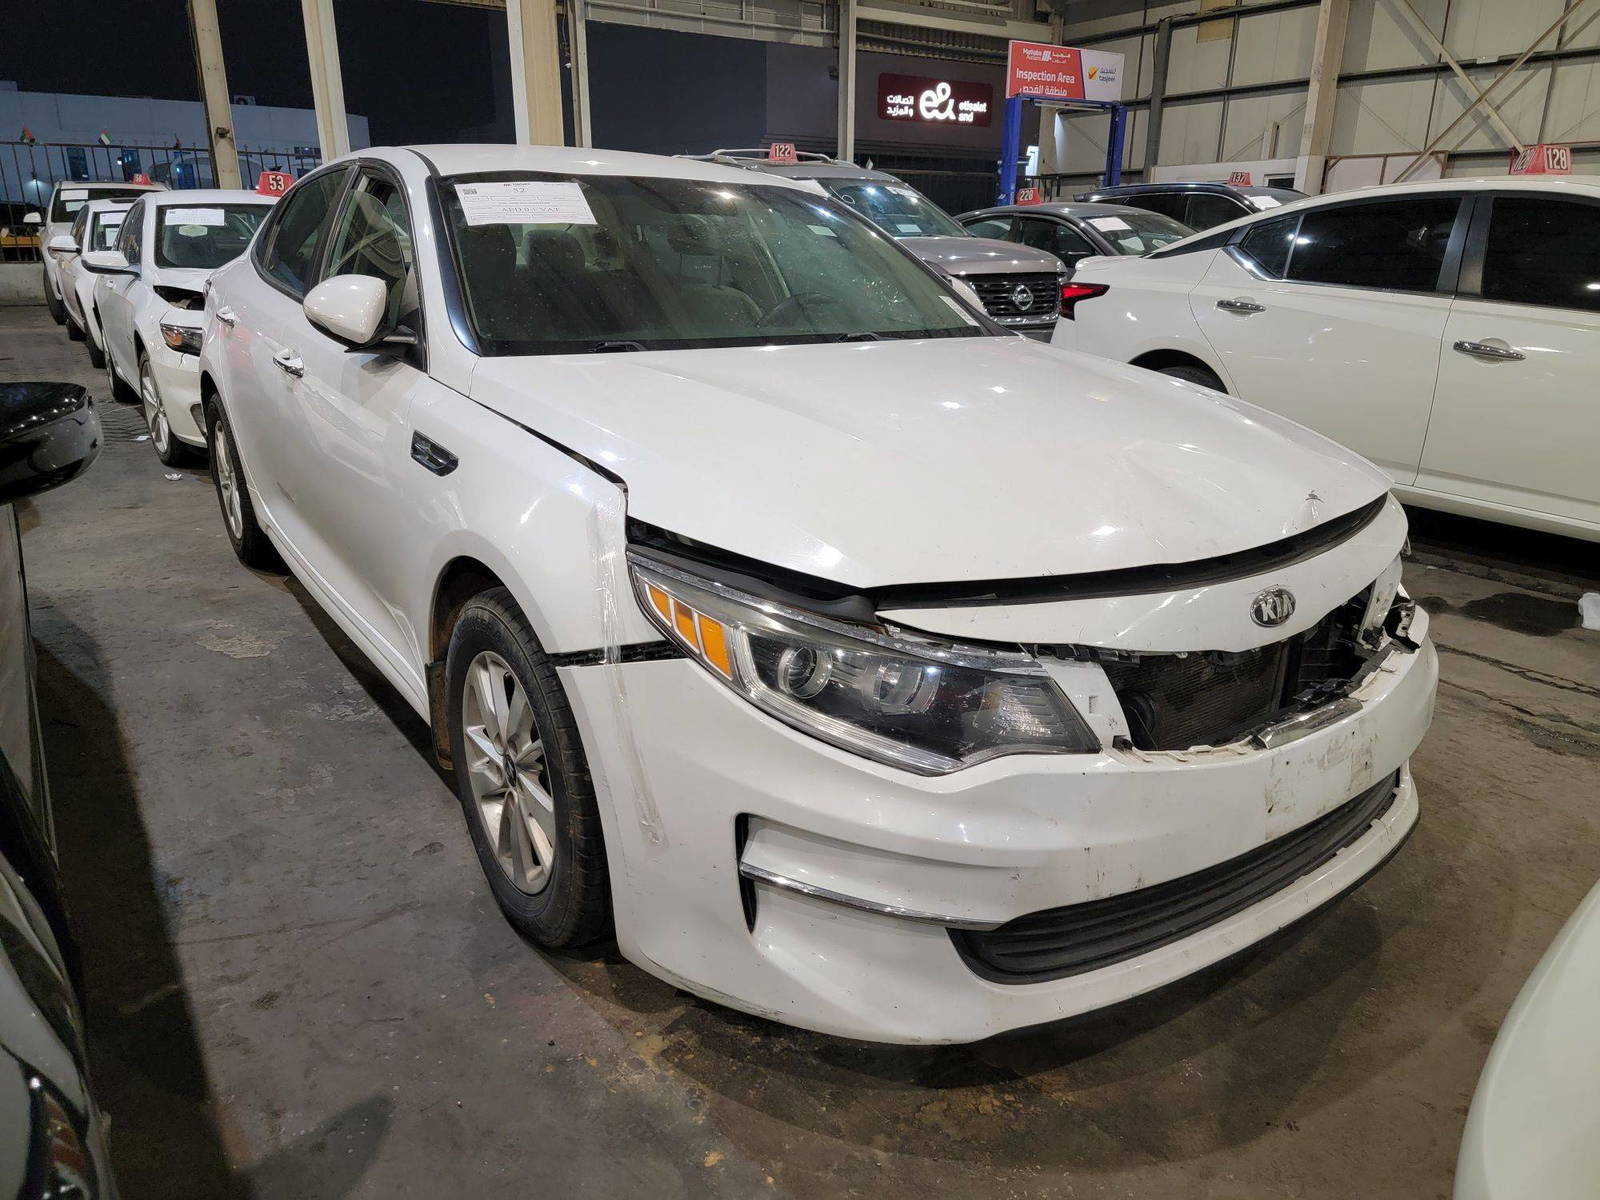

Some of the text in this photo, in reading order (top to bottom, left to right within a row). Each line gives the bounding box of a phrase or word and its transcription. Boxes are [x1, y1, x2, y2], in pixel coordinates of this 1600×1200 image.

[1016, 68, 1075, 84] Inspection Area
[958, 100, 987, 112] etisalat
[958, 111, 974, 122] and
[775, 144, 791, 157] 122
[1547, 148, 1567, 170] 128
[268, 175, 285, 190] 53
